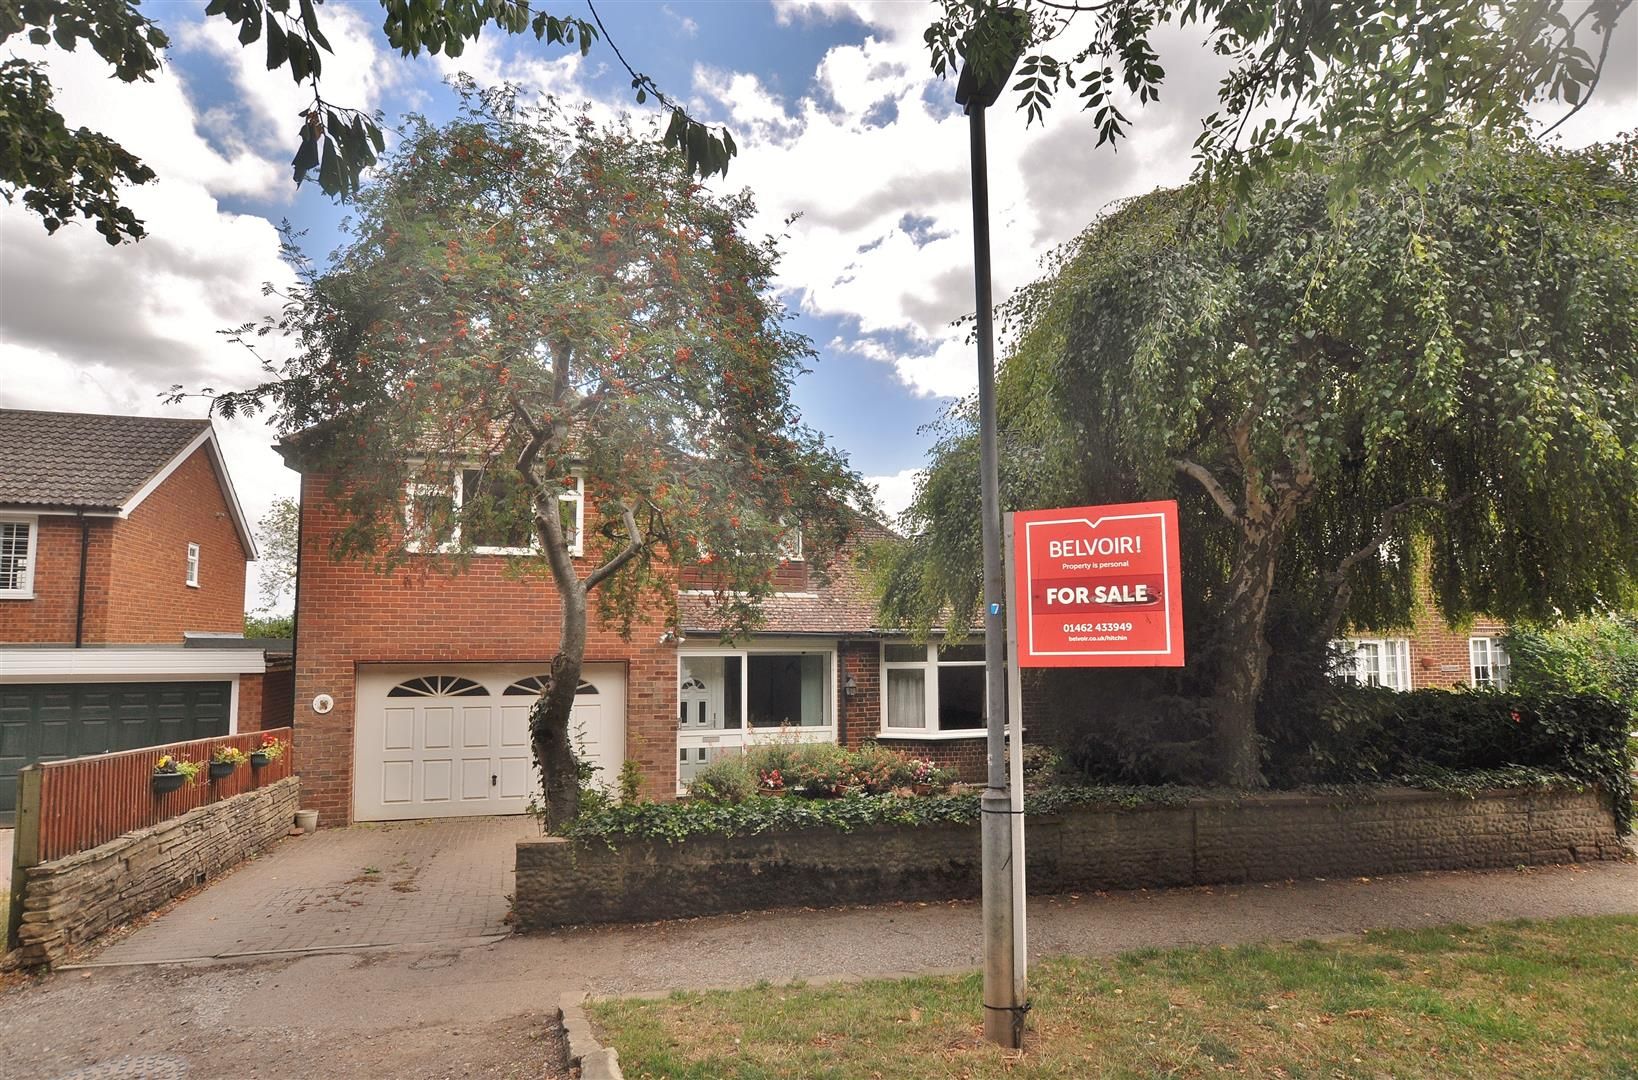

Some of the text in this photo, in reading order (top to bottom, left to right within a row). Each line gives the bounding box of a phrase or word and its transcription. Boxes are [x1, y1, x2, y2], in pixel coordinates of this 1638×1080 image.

[1049, 535, 1141, 558] BELVOIR!
[1062, 562, 1092, 571] Property
[1099, 560, 1129, 570] personal
[1046, 584, 1148, 605] FOR SALE
[991, 603, 1000, 615] 7
[1063, 622, 1133, 633] 01462 433949
[1068, 634, 1128, 642] belvoir.co.uk/hitchin
